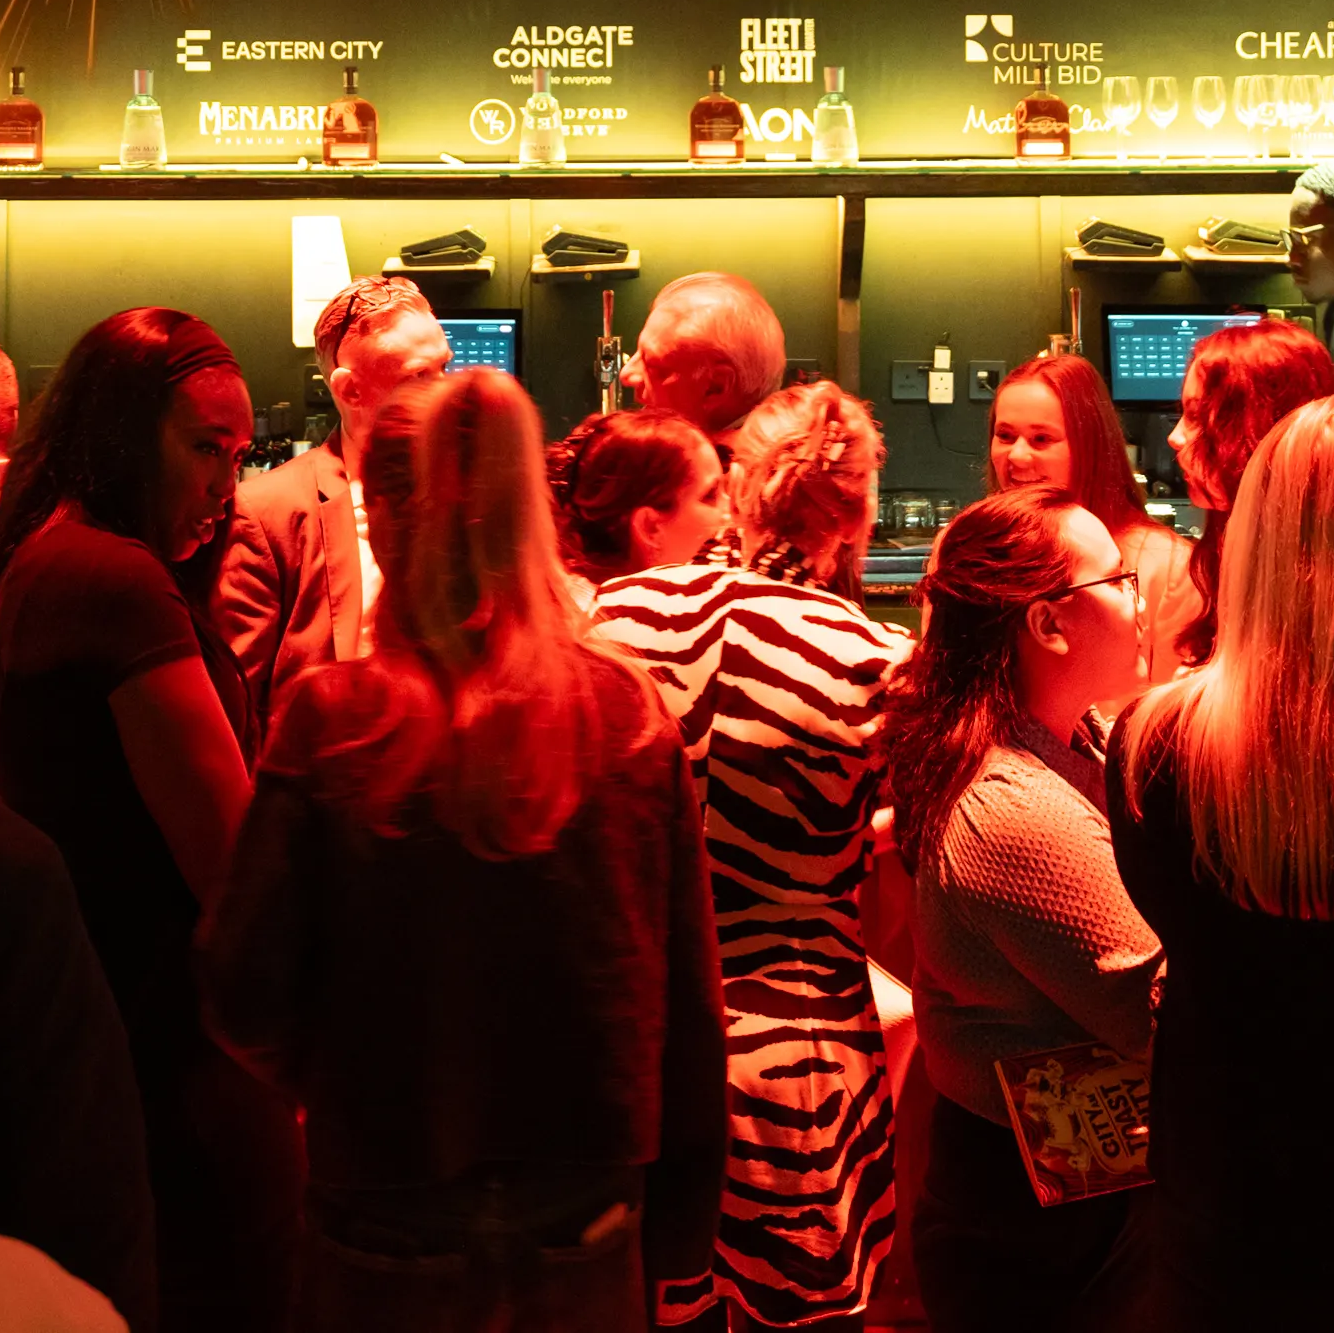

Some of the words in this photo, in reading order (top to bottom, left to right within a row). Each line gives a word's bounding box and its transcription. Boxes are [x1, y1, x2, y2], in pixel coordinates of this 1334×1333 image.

[510, 25, 634, 46] ALDGATE
[740, 18, 803, 50] FLEET
[221, 41, 325, 60] EASTERN
[329, 40, 383, 60] CITY
[492, 47, 614, 68] CONNECT
[992, 42, 1104, 62] CULTURE
[739, 50, 816, 83] STREET
[1057, 65, 1102, 85] BID
[510, 74, 561, 85] Wele
[562, 76, 613, 86] everyone
[199, 101, 331, 135] MENABR
[215, 137, 285, 145] PREMIUM
[1086, 1093, 1102, 1108] AM
[1100, 1084, 1148, 1157] TOAST
[1084, 1109, 1120, 1158] CITY
